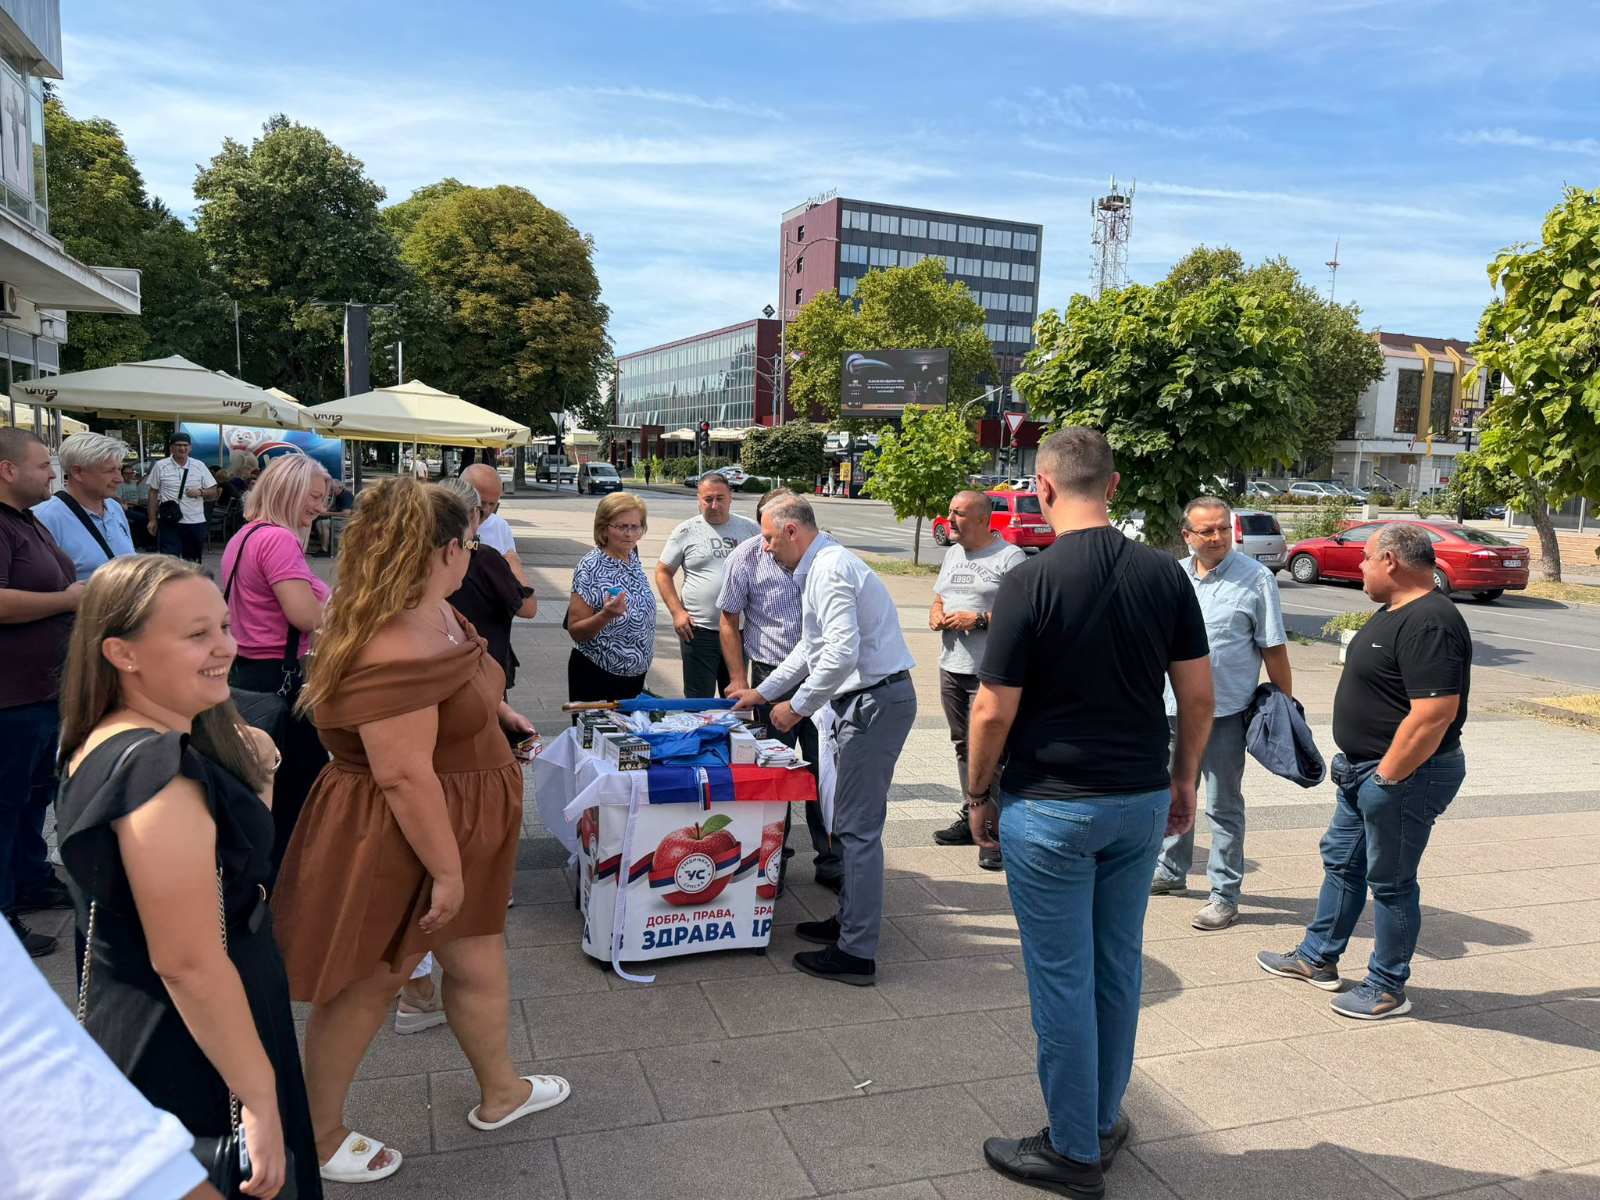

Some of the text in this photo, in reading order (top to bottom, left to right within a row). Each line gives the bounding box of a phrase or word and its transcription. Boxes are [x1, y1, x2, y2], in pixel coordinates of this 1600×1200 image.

[646, 908, 735, 928] ДОБРА, ПРАВА,
[641, 920, 736, 950] ЗДРАВА
